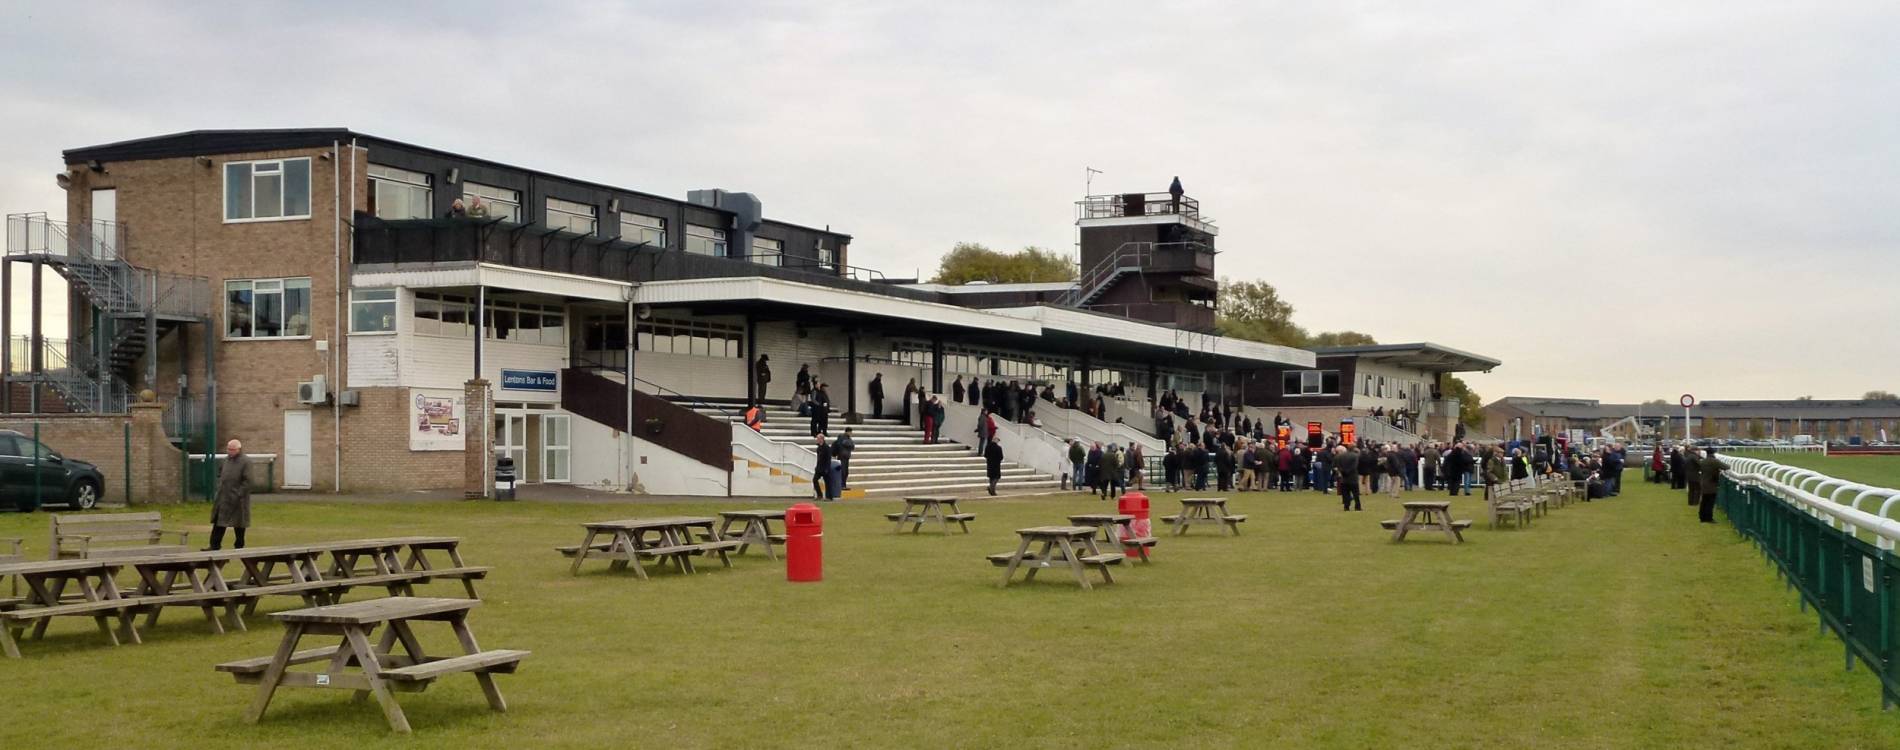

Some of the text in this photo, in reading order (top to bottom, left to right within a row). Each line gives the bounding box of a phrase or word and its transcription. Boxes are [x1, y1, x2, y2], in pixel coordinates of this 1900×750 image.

[504, 375, 556, 385] Lentons Bar & Food
